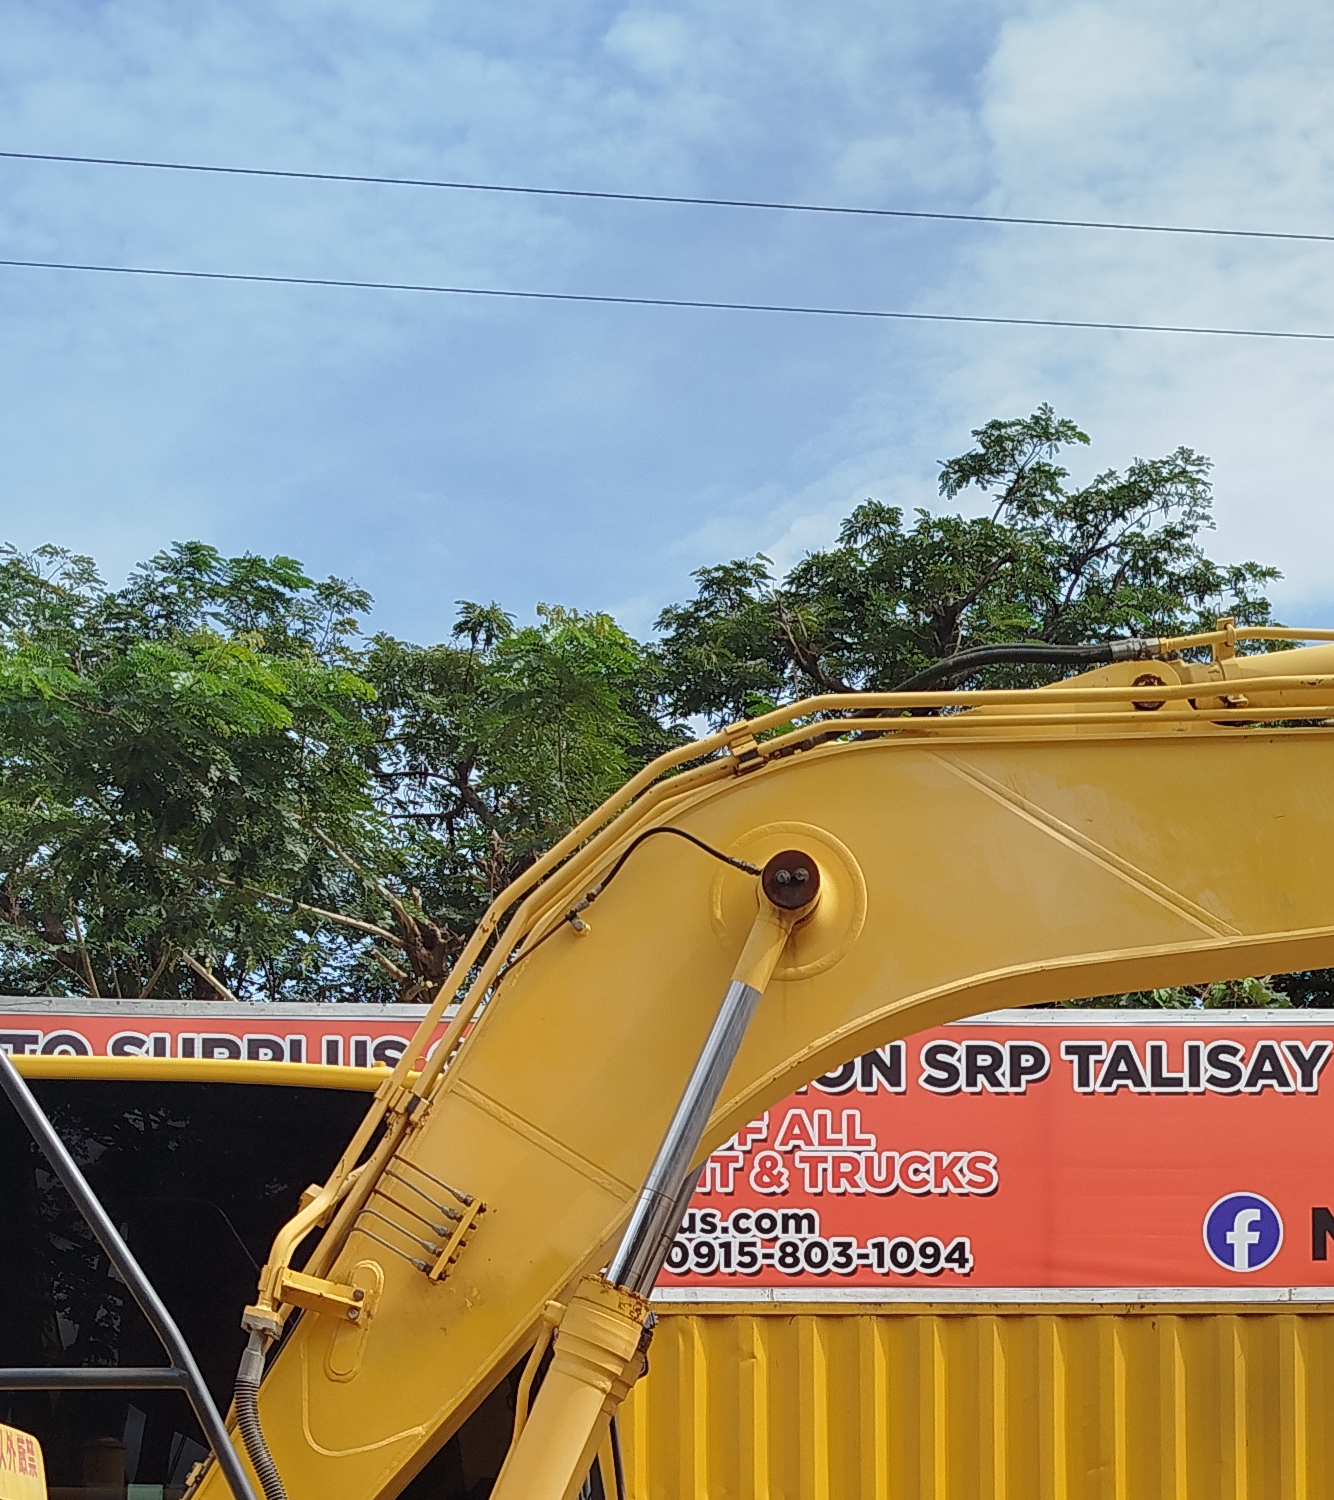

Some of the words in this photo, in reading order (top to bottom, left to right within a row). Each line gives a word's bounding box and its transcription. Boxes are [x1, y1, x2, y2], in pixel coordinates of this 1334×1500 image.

[922, 1040, 1050, 1094] SRP
[1065, 1040, 1332, 1095] TALISAY
[774, 1109, 876, 1151] ALL
[749, 1151, 789, 1193] &
[795, 1151, 1000, 1195] TRUCKS
[677, 1207, 820, 1239] us.com
[663, 1236, 972, 1274] 0915-803-1094
